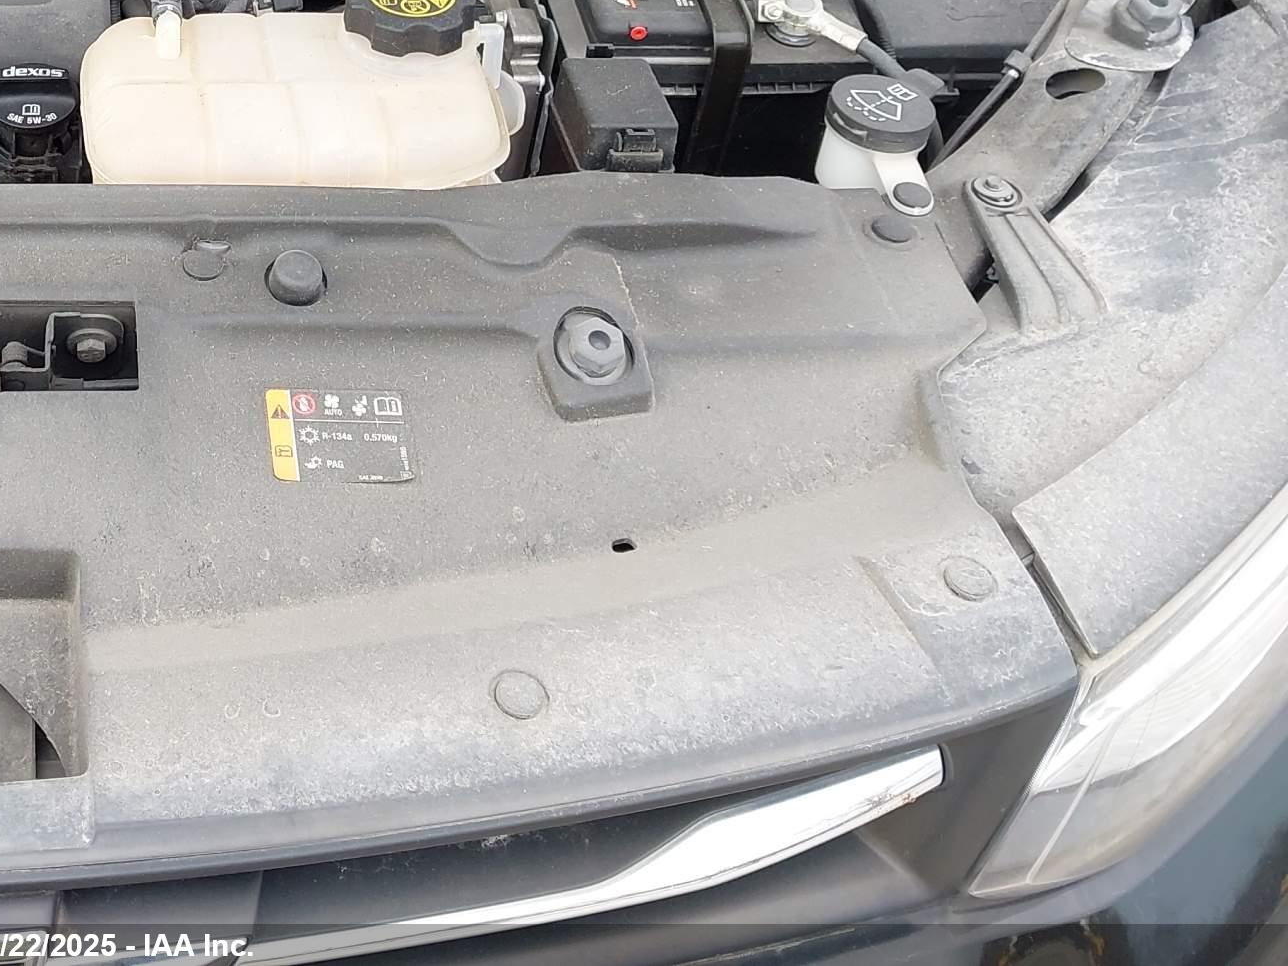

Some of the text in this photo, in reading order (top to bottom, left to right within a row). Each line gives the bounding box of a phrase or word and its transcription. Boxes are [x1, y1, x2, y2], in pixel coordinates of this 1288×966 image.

[2, 66, 65, 77] dexos
[7, 112, 57, 124] SAE 5W-30
[324, 408, 343, 416] AUTO
[321, 431, 353, 441] R-134a
[326, 459, 345, 469] PAG
